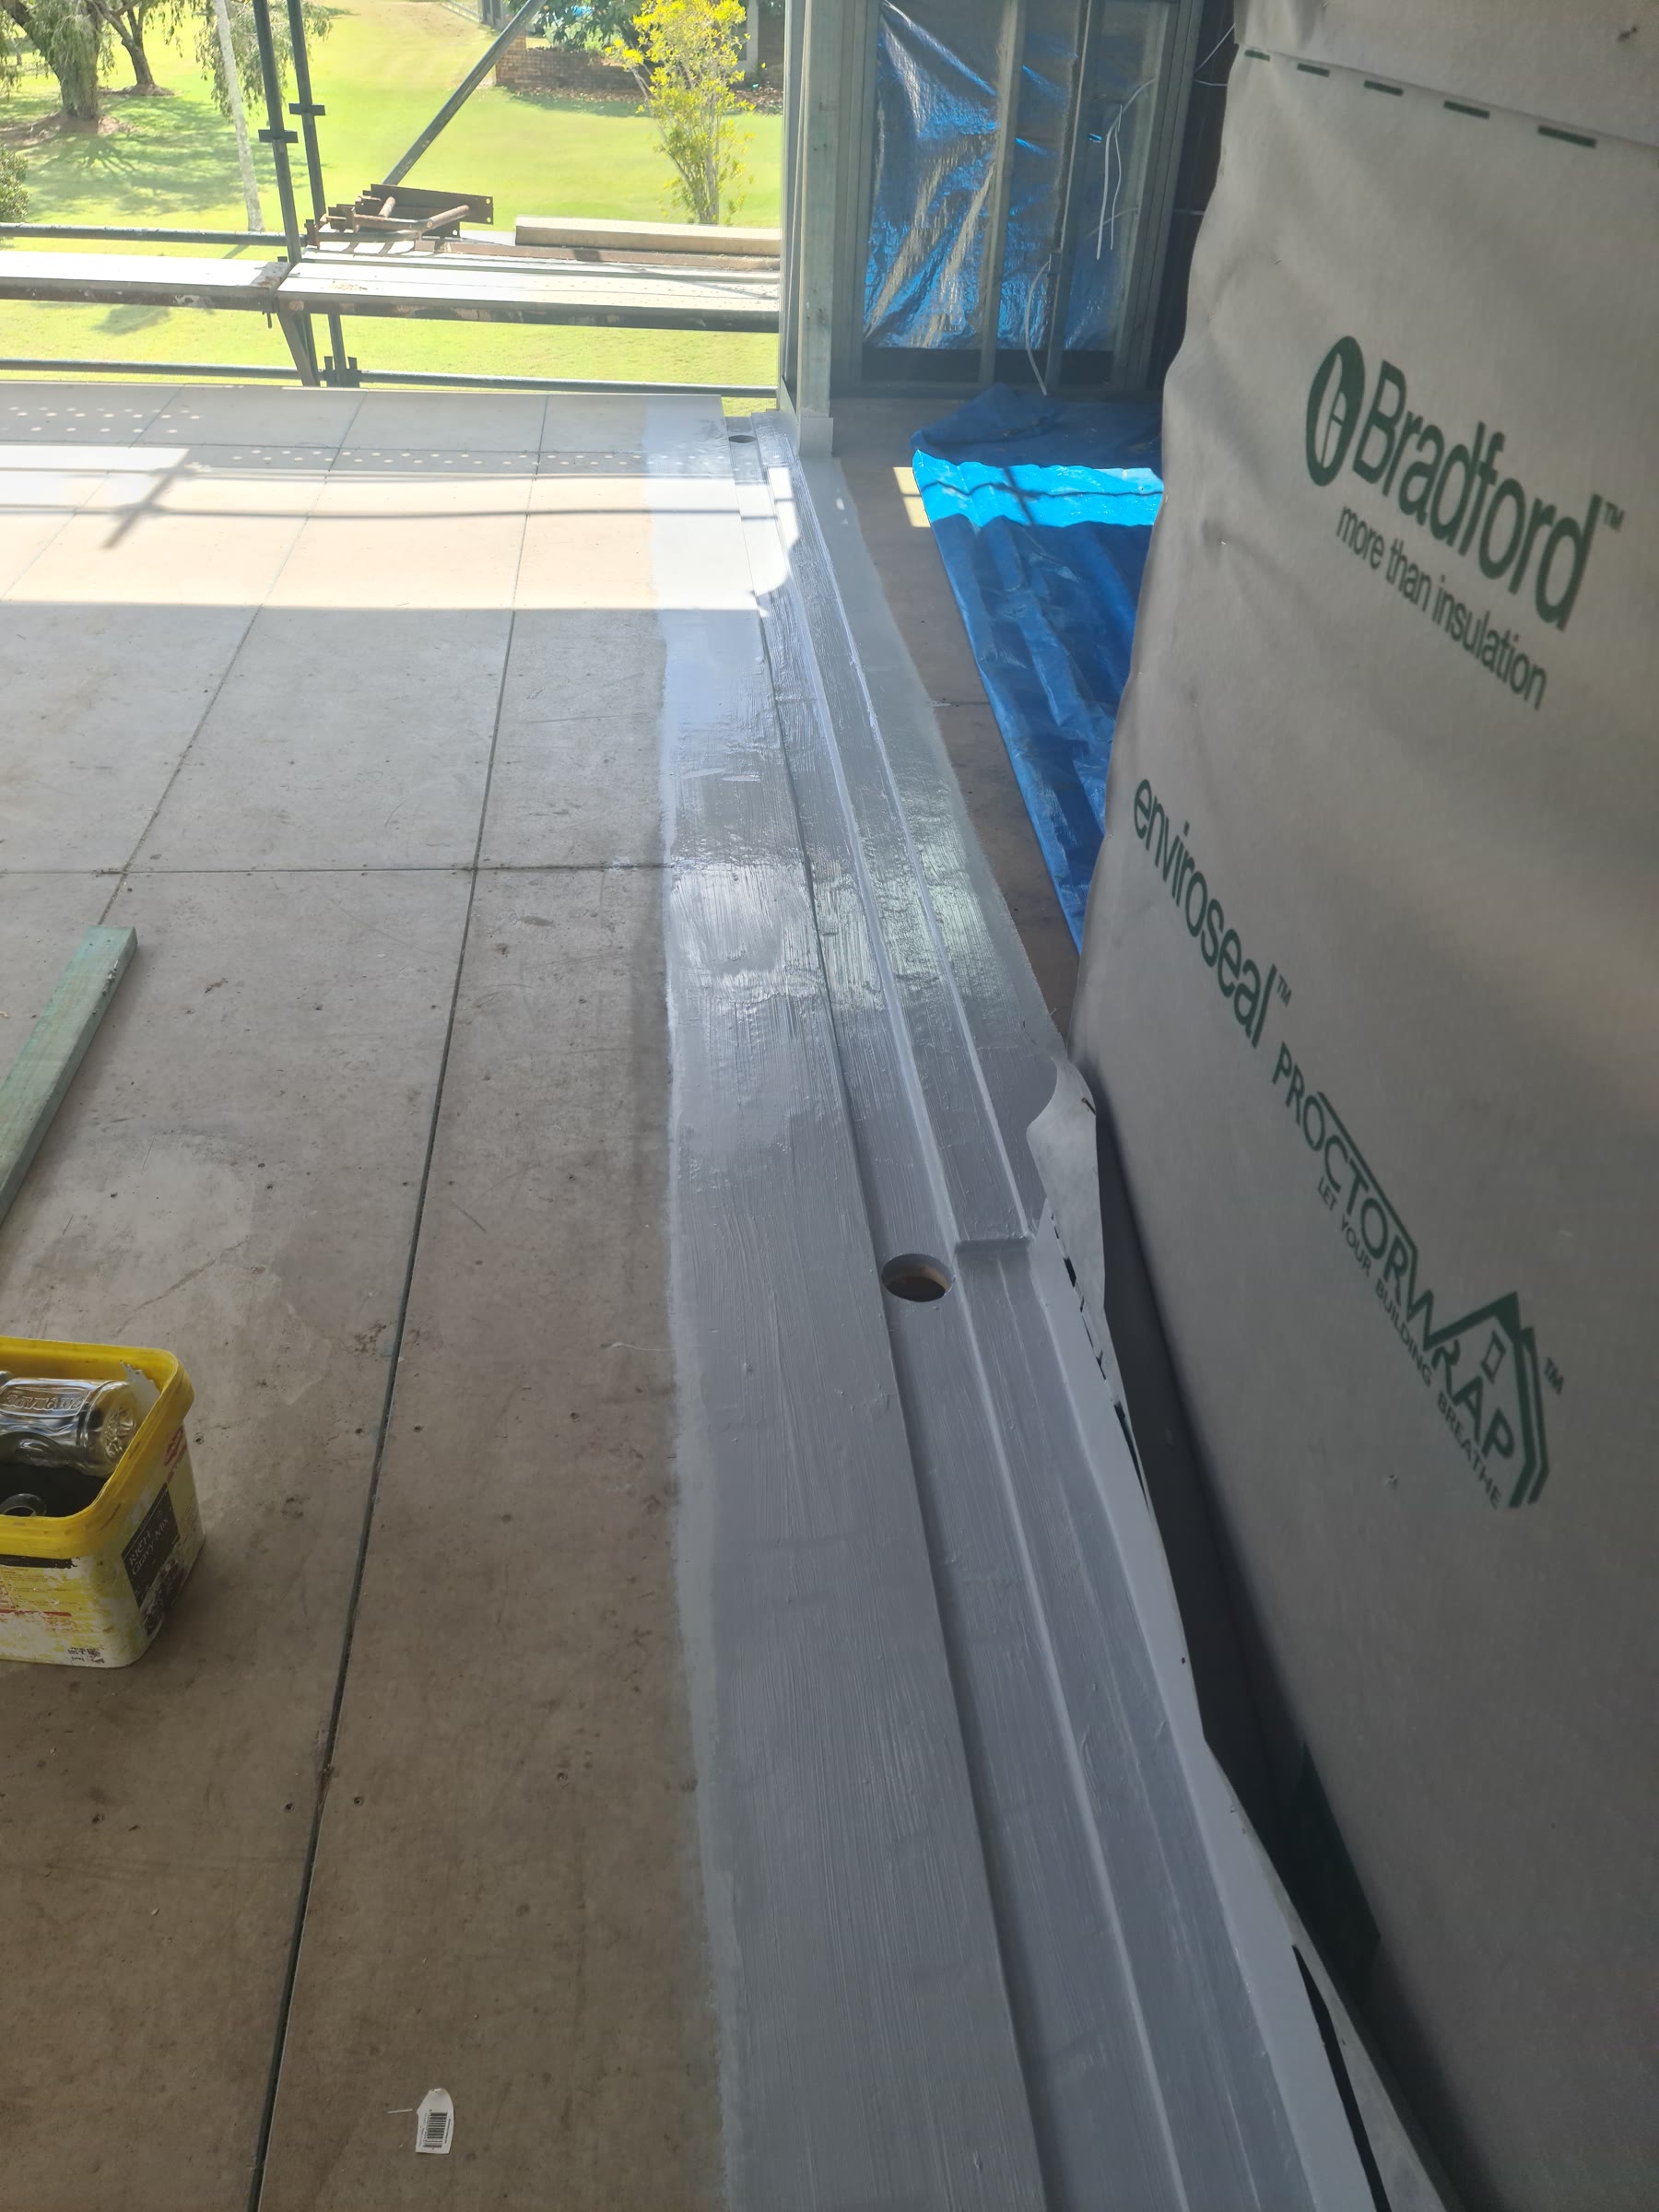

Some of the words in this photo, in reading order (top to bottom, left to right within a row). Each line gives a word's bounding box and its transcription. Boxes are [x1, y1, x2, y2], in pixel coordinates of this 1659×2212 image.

[1335, 505, 1383, 571] more
[1385, 538, 1433, 613] than
[1432, 574, 1548, 712] insulation
[1352, 359, 1603, 632] Bradford
[1134, 779, 1277, 1049] enviroseal
[1317, 1176, 1337, 1211] LET
[1340, 1213, 1372, 1278] YOUR
[1374, 1277, 1434, 1388] BUILDING
[1437, 1390, 1502, 1510] BREATHE
[128, 1530, 151, 1567] RICH
